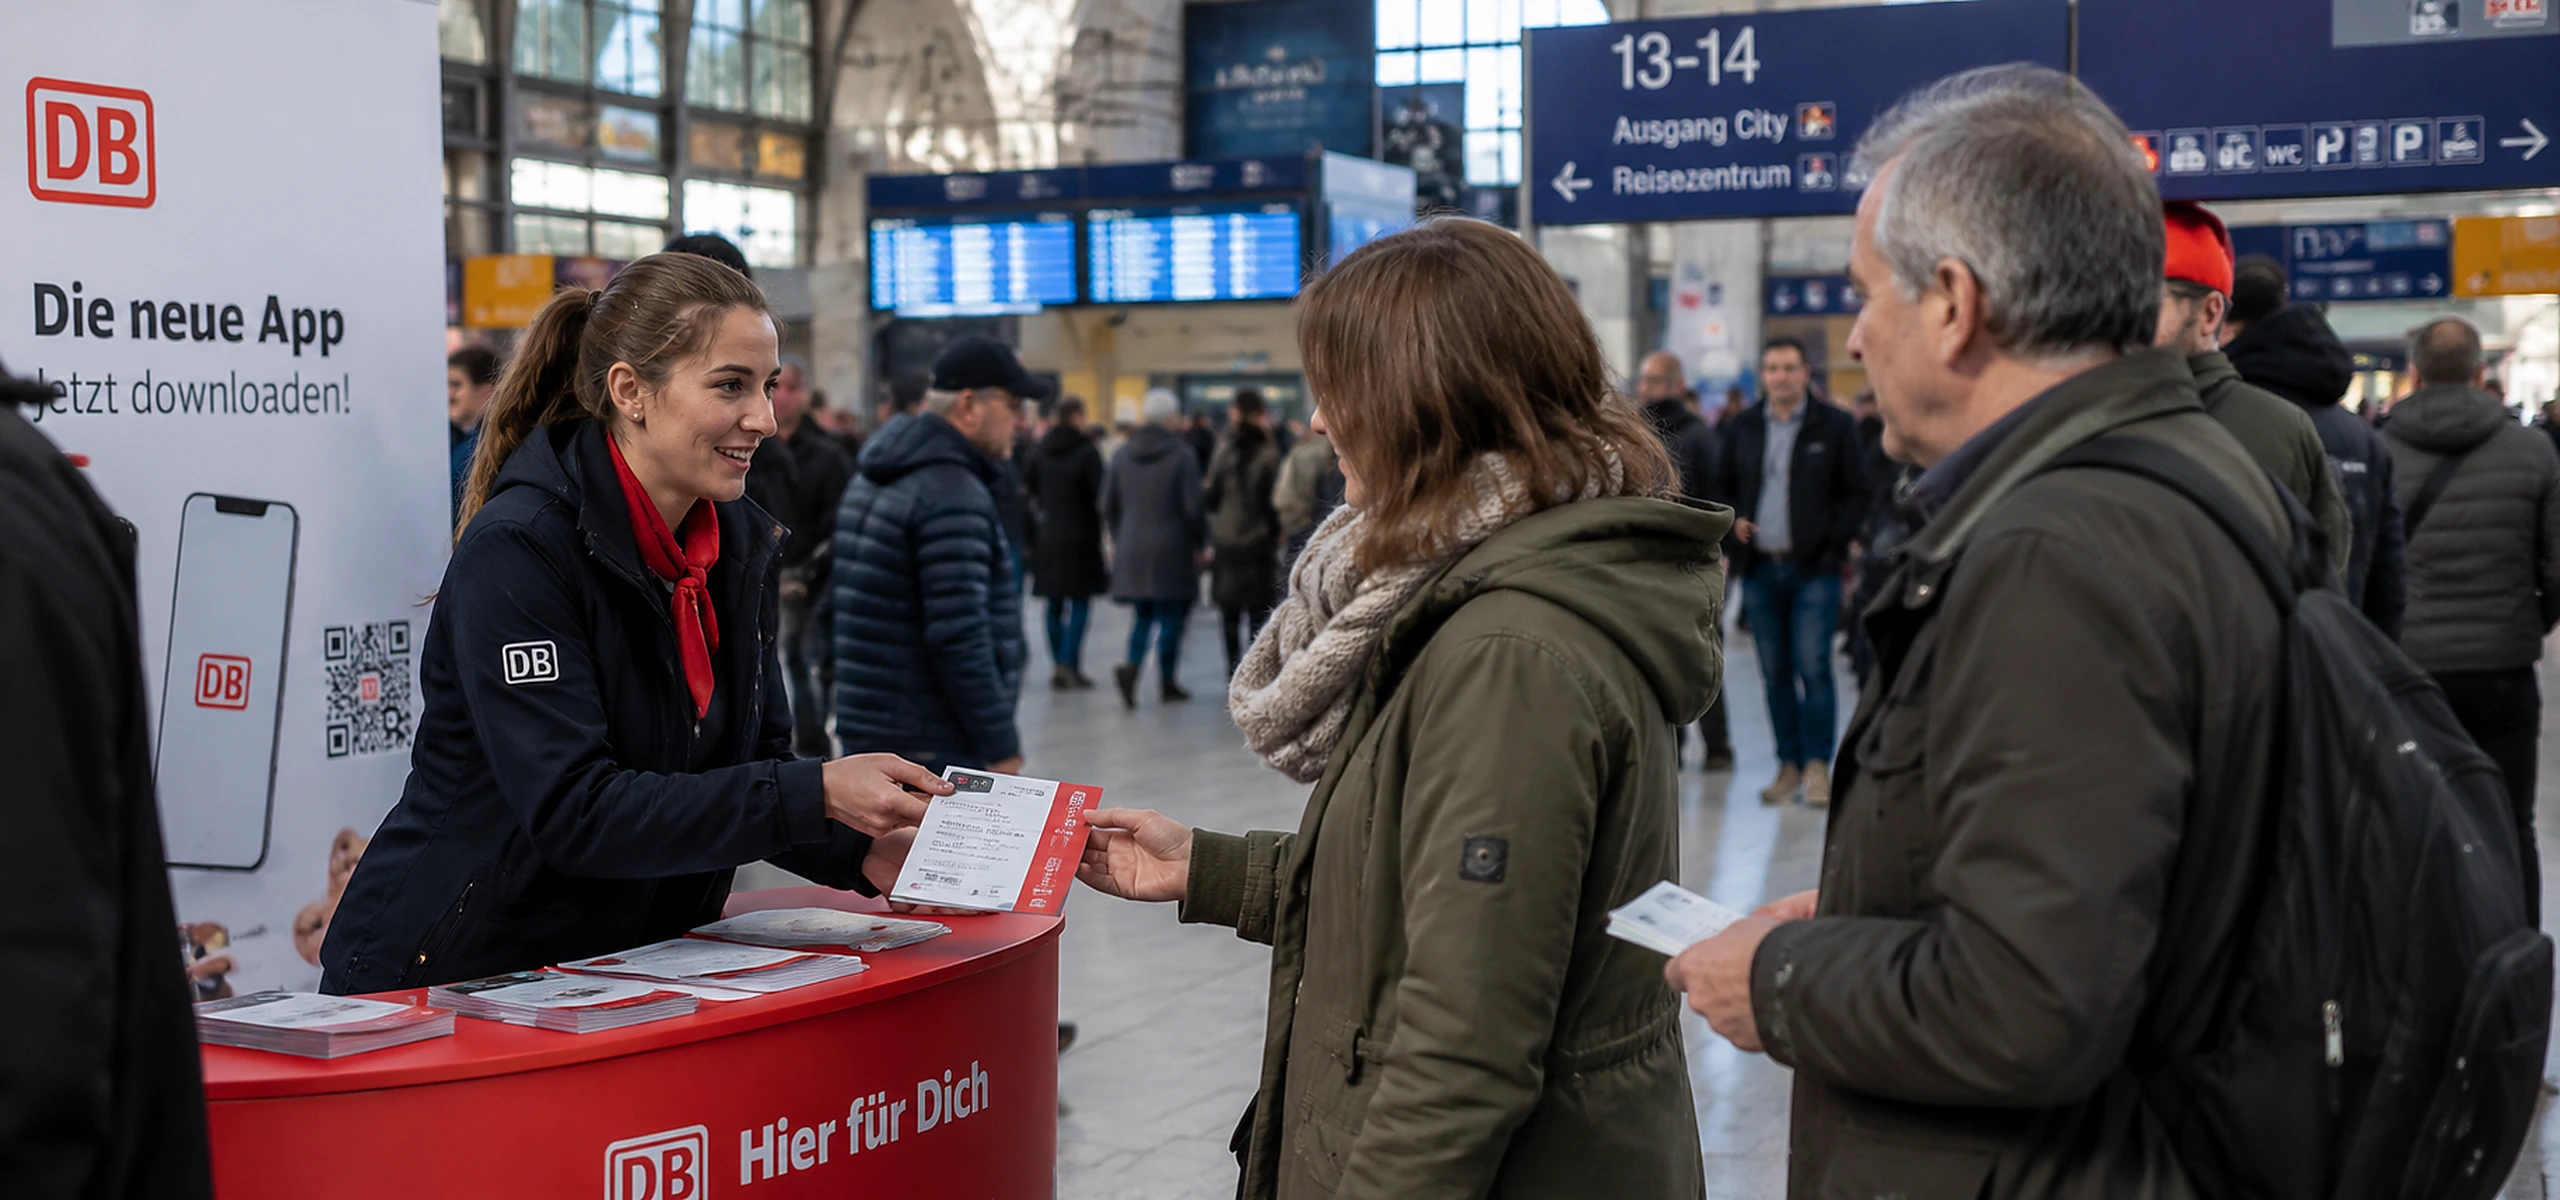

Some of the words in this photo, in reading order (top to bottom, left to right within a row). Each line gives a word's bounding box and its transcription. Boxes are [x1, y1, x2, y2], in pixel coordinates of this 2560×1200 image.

[1611, 26, 1761, 91] 13-14
[45, 101, 140, 186] DB
[1612, 114, 1728, 149] Ausgang
[1733, 106, 1790, 144] City
[2394, 124, 2424, 160] P
[1611, 162, 1791, 195] Reisezentrum
[2266, 143, 2303, 166] WC
[33, 280, 114, 338] Die
[131, 299, 244, 342] neue
[258, 294, 345, 357] App
[33, 367, 119, 423] Jetzt
[131, 369, 351, 416] downloaden!
[203, 663, 244, 701] DB
[508, 647, 552, 678] DB
[740, 1117, 836, 1185] Hier
[846, 1090, 907, 1155] für
[917, 1059, 989, 1133] Dich
[622, 1147, 694, 1200] DB
